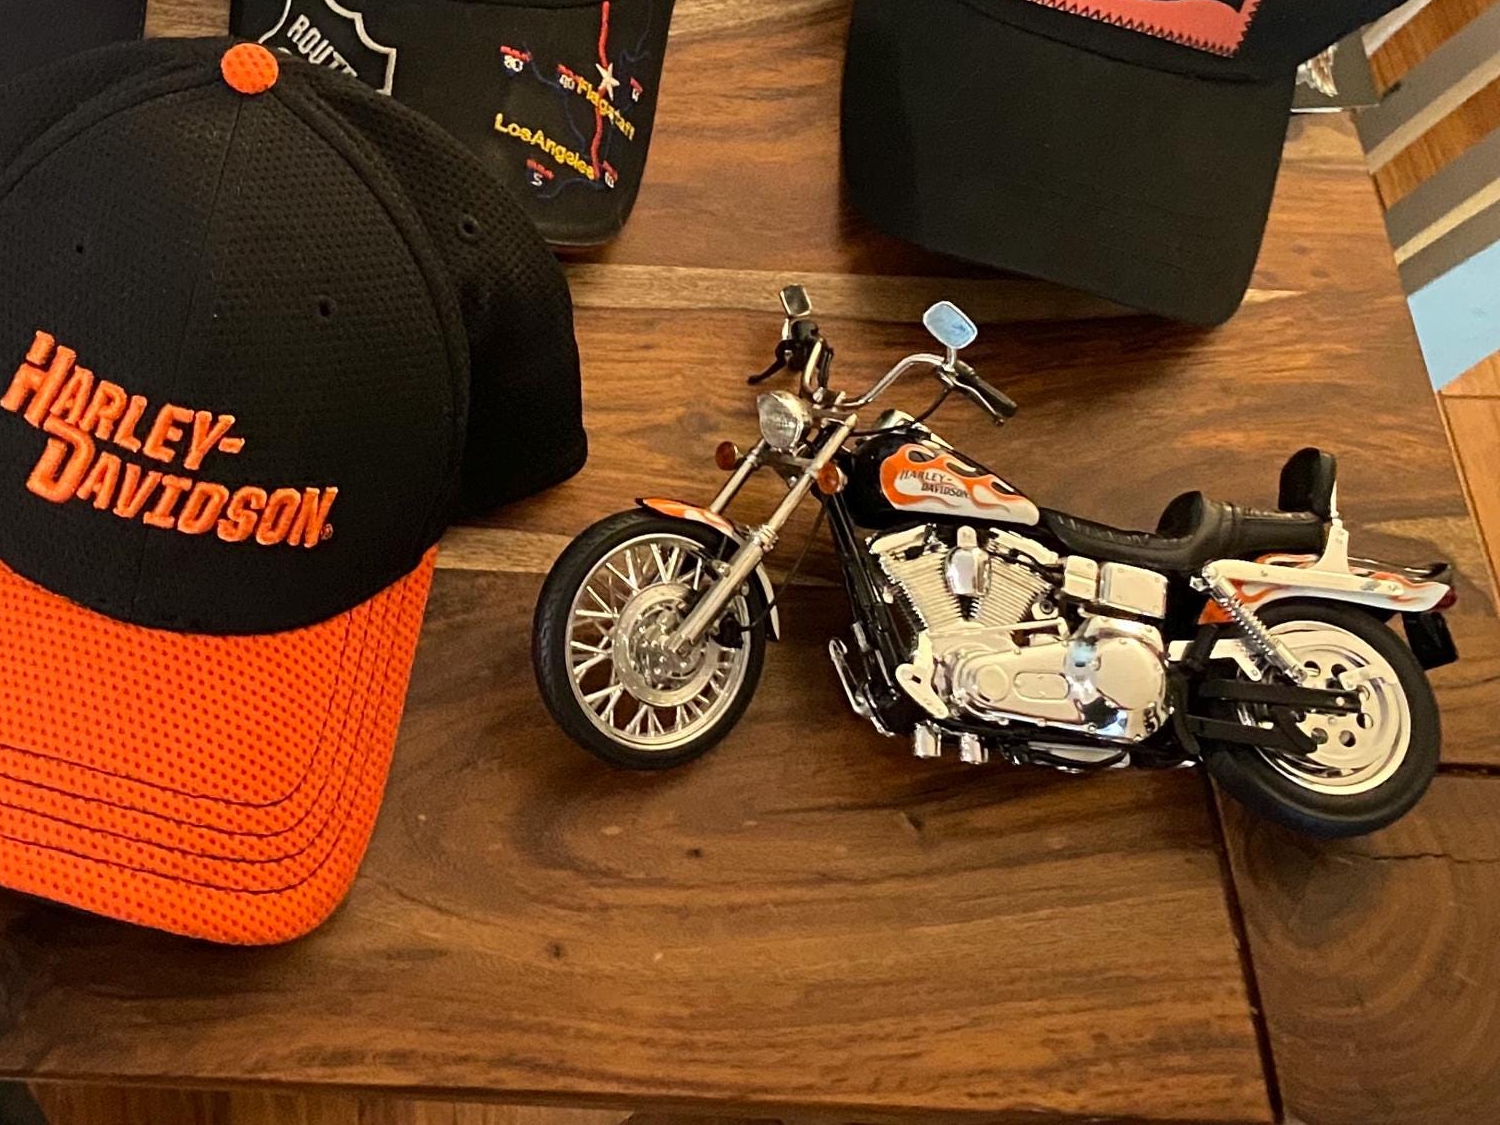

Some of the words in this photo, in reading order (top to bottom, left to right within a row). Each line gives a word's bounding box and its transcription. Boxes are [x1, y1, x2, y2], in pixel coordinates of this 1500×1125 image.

[0, 329, 246, 471] HARLEY-
[26, 413, 339, 549] DAVIDSON
[920, 481, 969, 499] DAVIDSON
